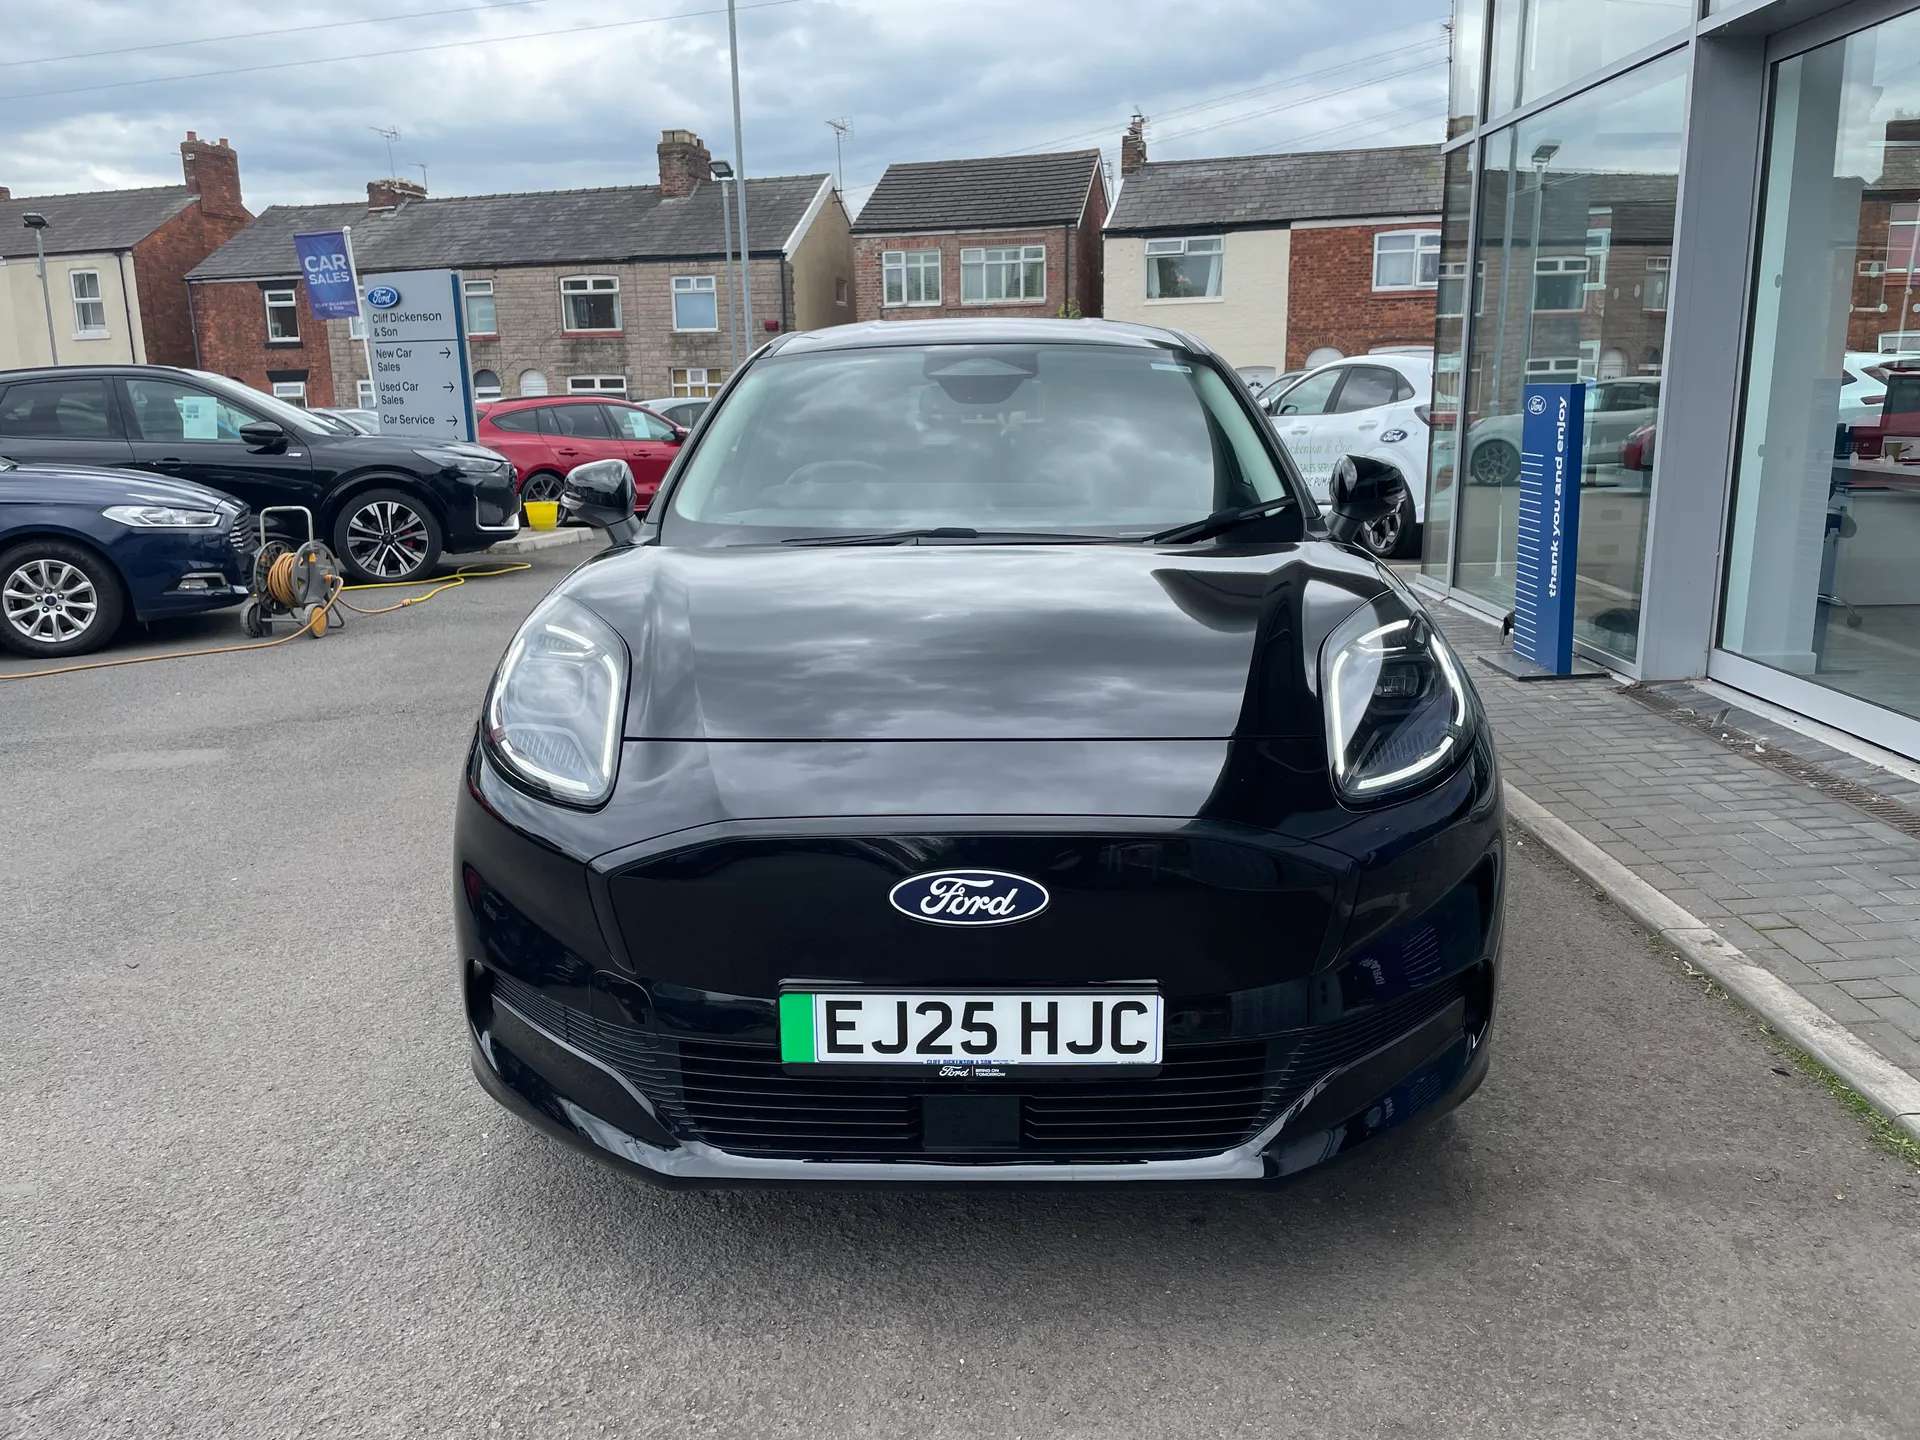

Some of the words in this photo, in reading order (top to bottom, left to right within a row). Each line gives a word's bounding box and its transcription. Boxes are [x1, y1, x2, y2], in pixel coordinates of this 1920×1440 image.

[304, 254, 347, 273] CAR
[309, 271, 350, 285] SALES
[372, 312, 389, 324] Cliff
[390, 311, 442, 323] Dickenson
[374, 329, 380, 337] &
[381, 327, 398, 337] Son
[375, 349, 394, 359] New
[396, 347, 412, 358] Car
[377, 361, 401, 373] Sales
[379, 381, 401, 392] Used
[402, 381, 419, 391] Car
[381, 394, 405, 406] Sales
[383, 414, 399, 425] Car
[400, 414, 435, 425] Service
[1556, 395, 1569, 453] enjoy
[1554, 455, 1564, 497] and
[1551, 499, 1562, 536] you
[1548, 540, 1560, 598] thank
[919, 876, 1019, 916] Ford
[825, 1000, 998, 1055] EJ25
[1020, 1000, 1149, 1055] HJC
[938, 1065, 970, 1077] Ford
